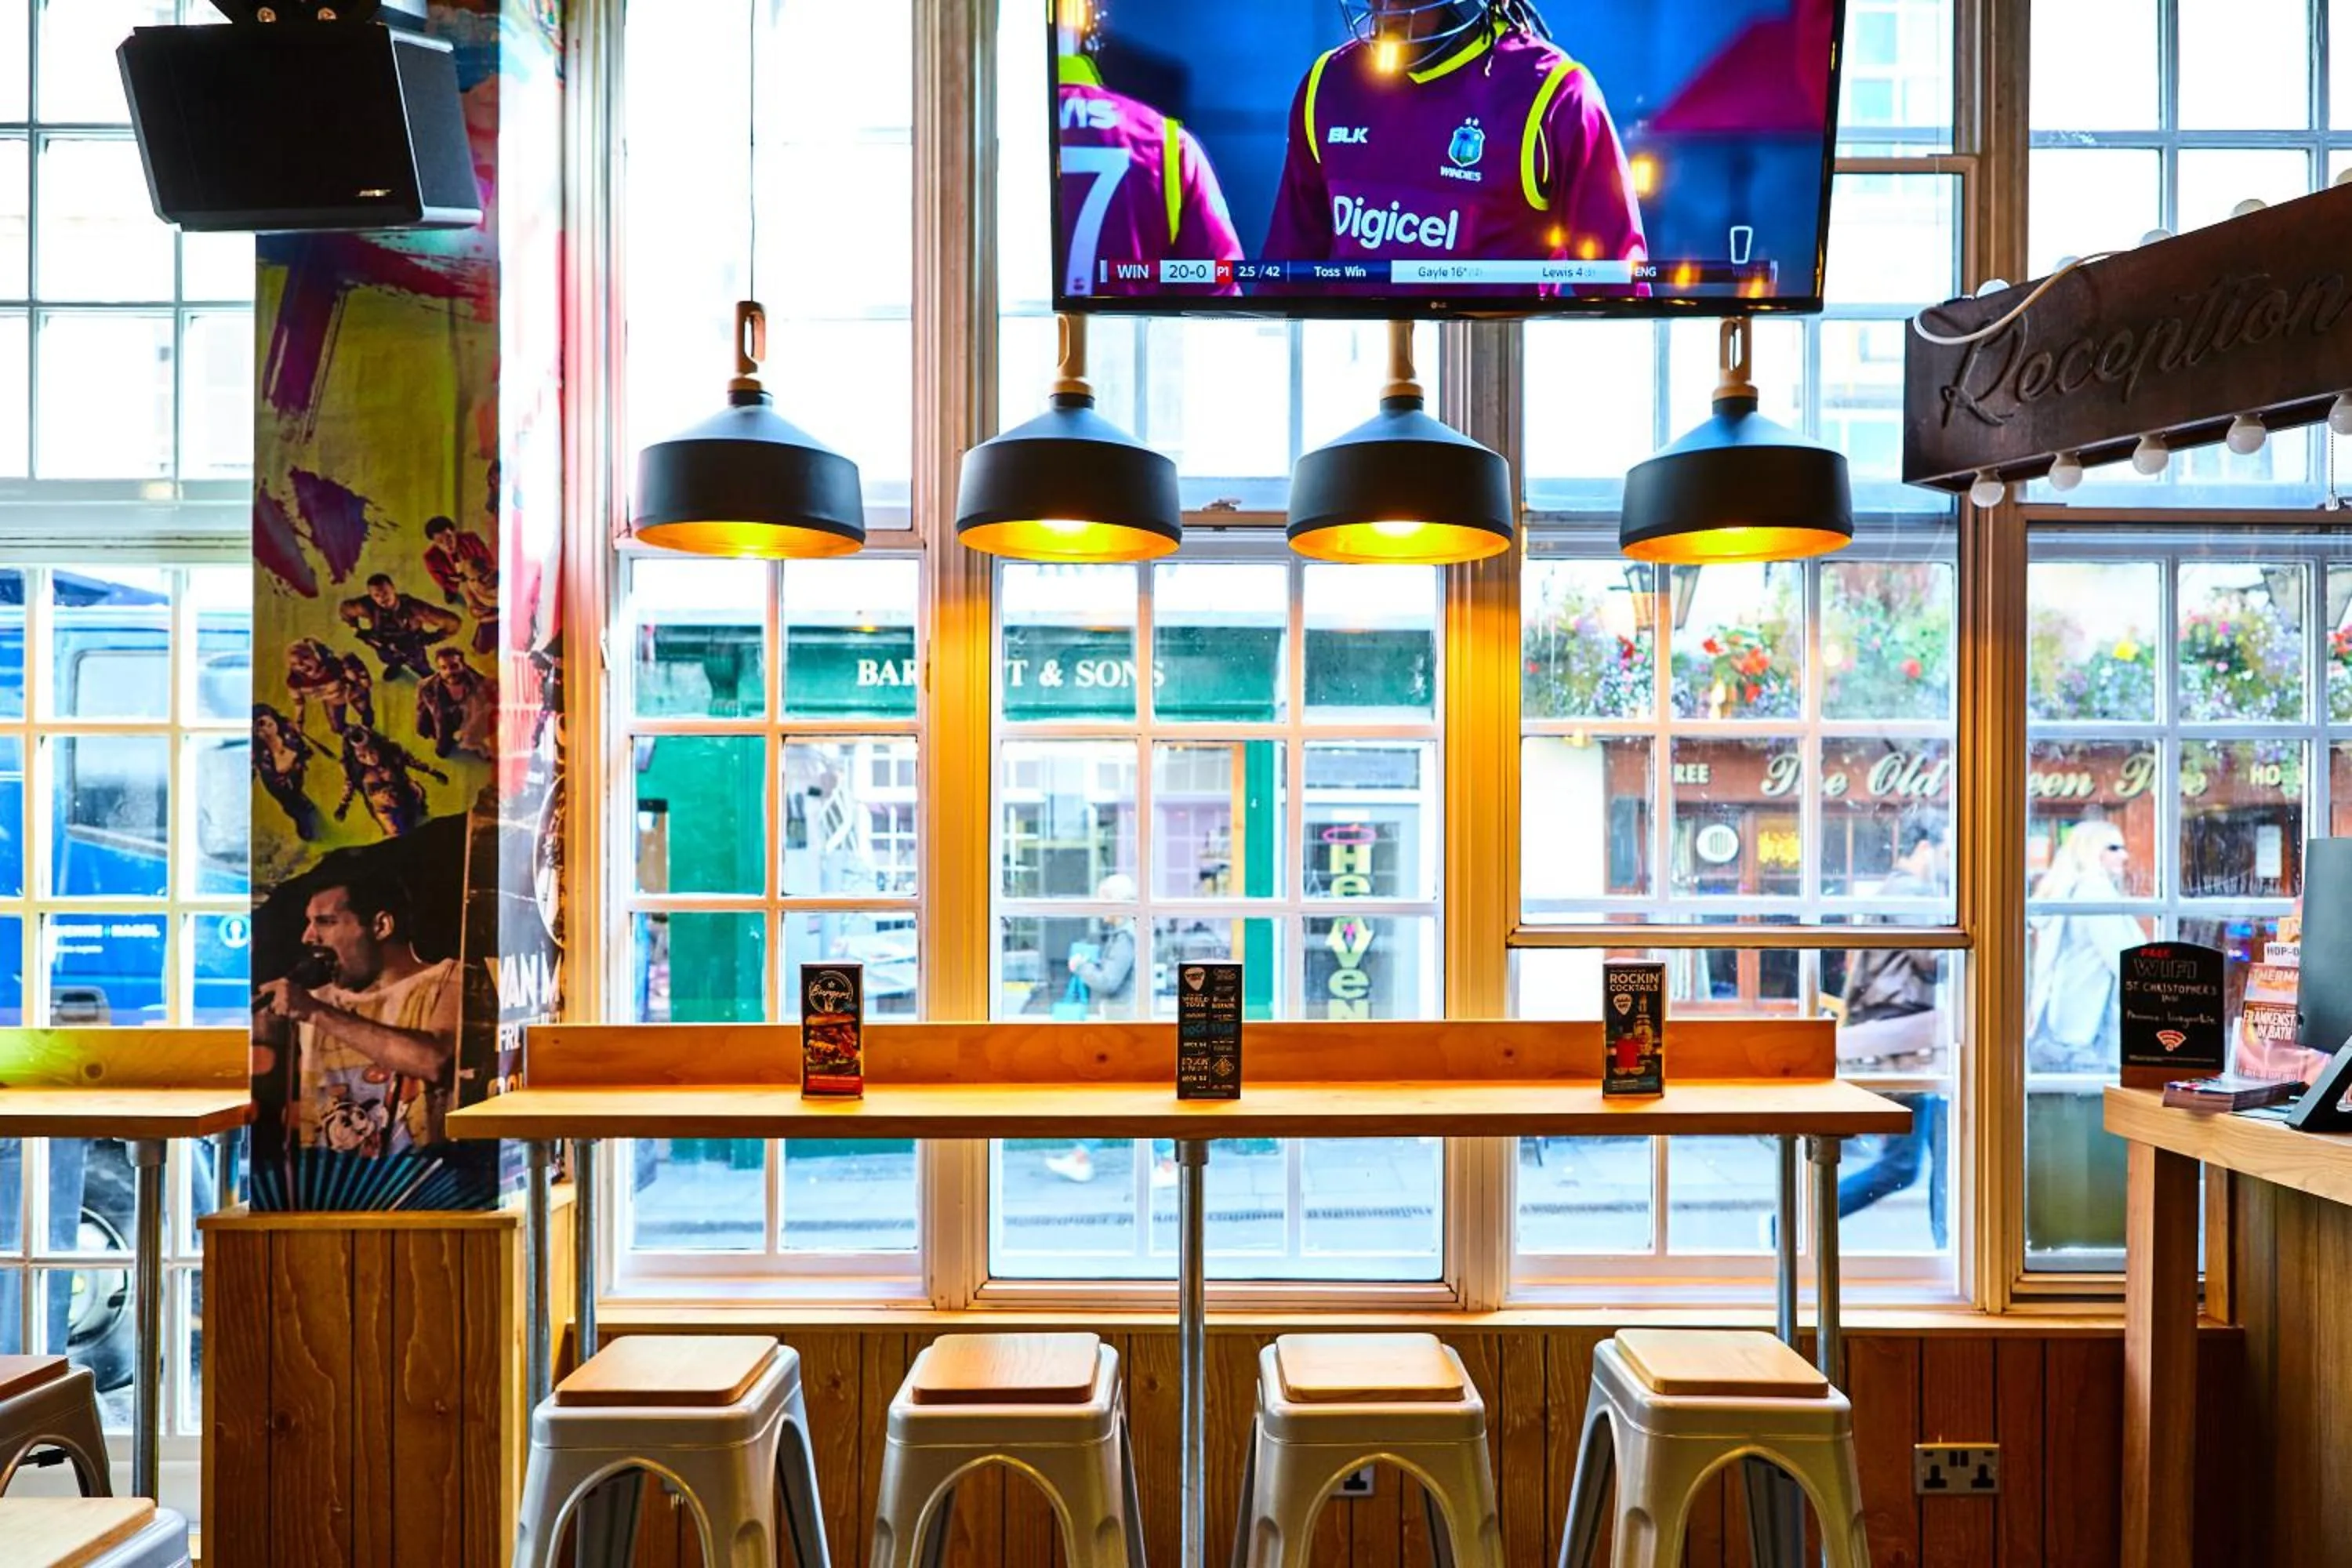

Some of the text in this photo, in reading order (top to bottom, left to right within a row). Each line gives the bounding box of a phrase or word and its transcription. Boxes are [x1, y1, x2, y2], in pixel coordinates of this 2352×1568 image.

[1327, 126, 1369, 143] BLK
[1334, 195, 1459, 250] Digicel
[1116, 264, 1149, 279] WIN
[1168, 264, 1207, 279] 20-0
[1216, 267, 1230, 278] P1
[1313, 266, 1367, 277] Toss Win
[1418, 267, 1448, 280] Gayle
[1542, 267, 1573, 277] Lewis
[1635, 266, 1657, 278] ENG
[1939, 272, 2352, 429] Reception
[1039, 659, 1063, 687] &
[1672, 763, 1709, 783] REE
[1867, 752, 1950, 797] Old
